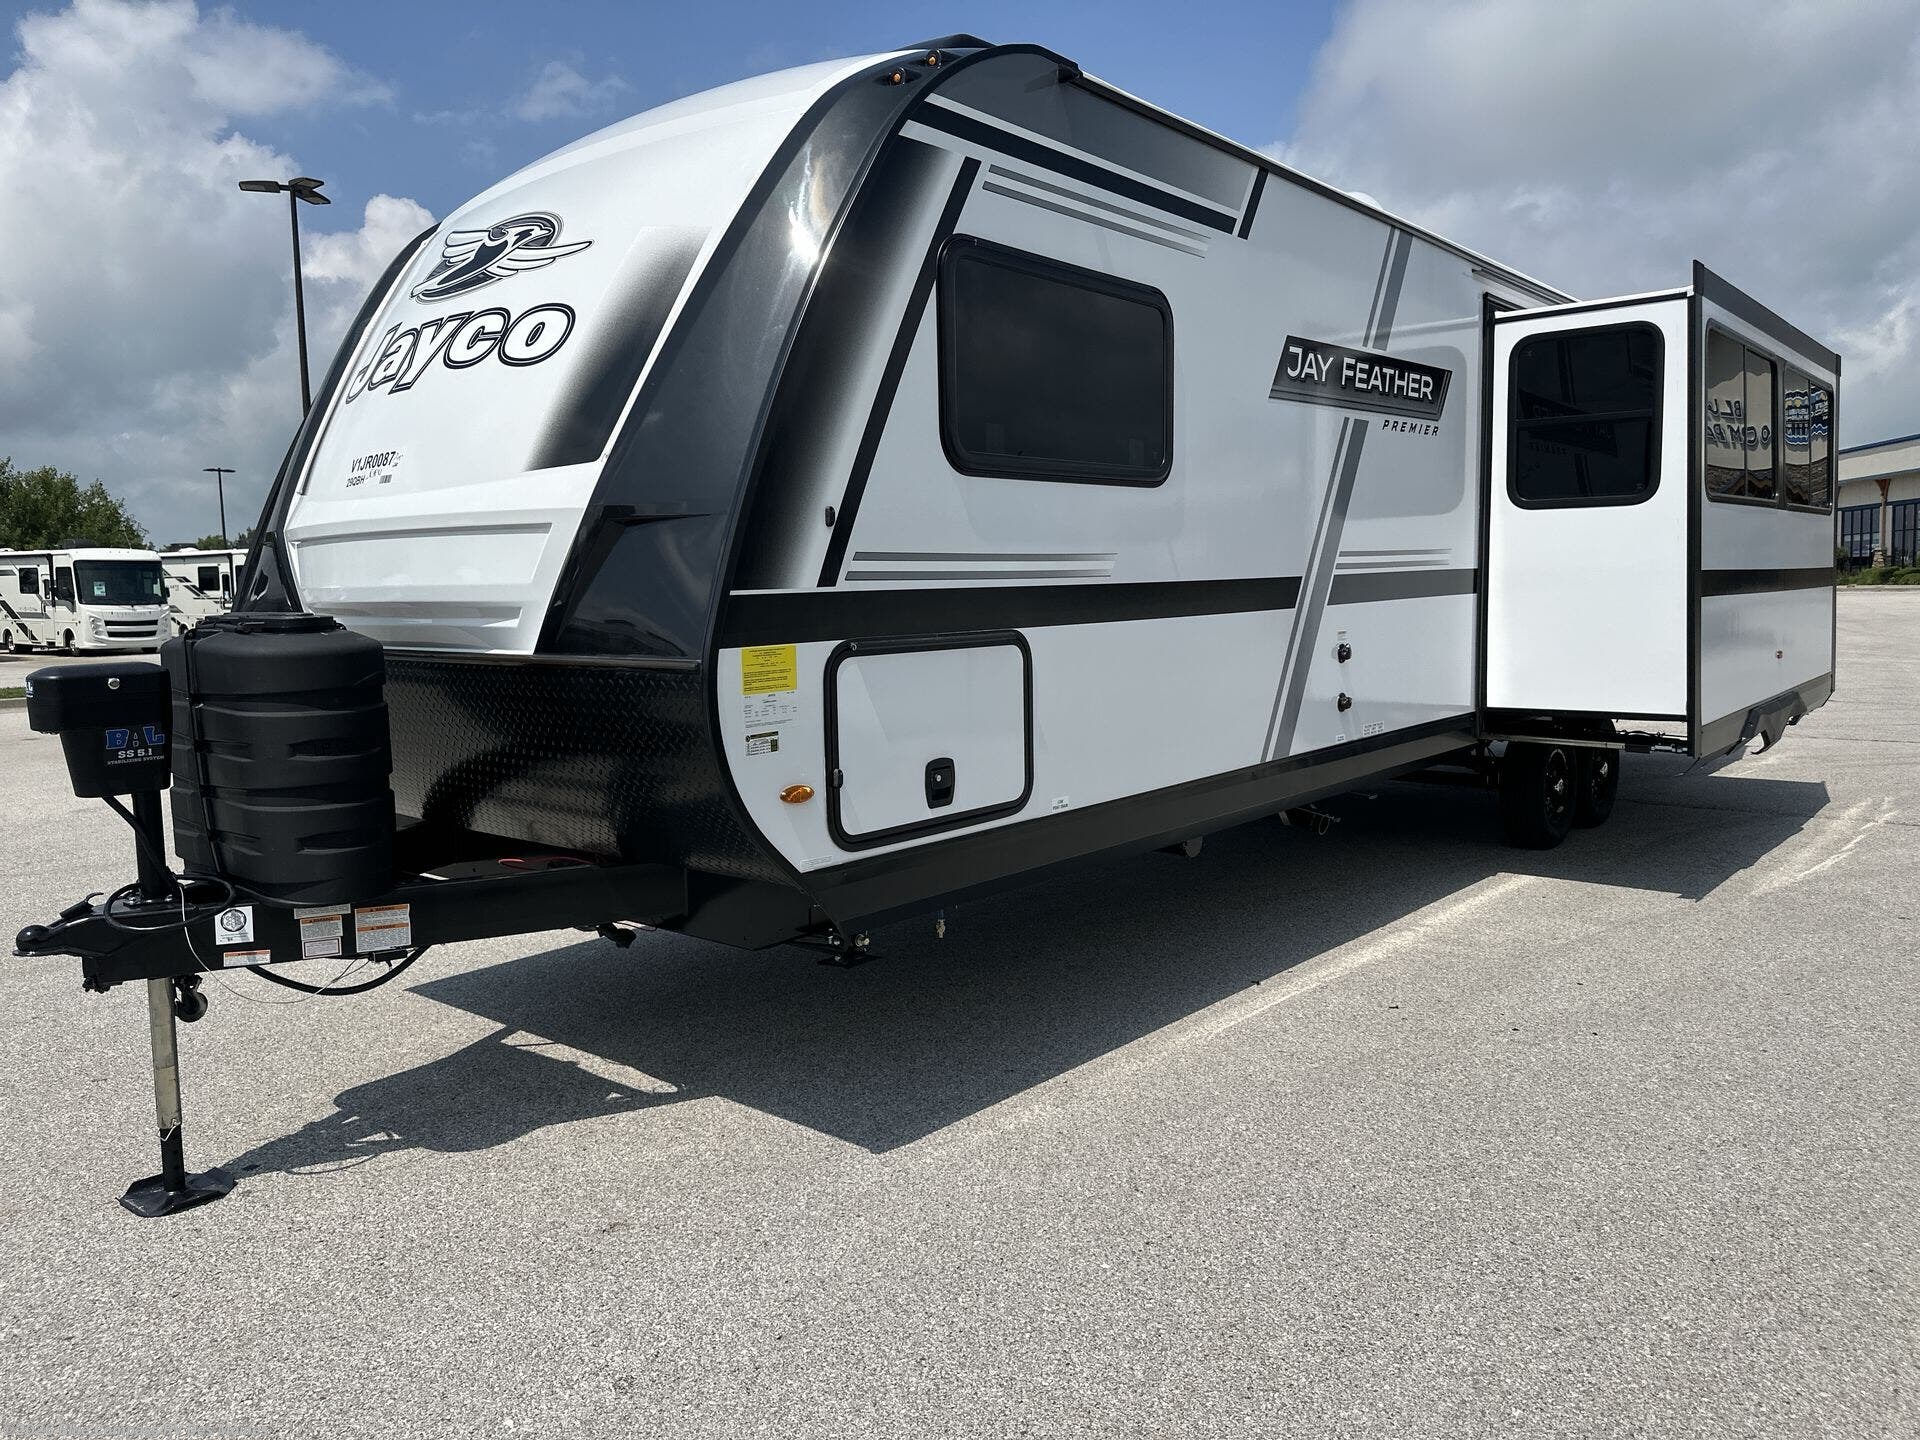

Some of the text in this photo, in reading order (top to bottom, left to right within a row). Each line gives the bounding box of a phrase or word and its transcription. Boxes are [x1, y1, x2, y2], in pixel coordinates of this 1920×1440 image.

[345, 303, 576, 405] Jayco
[1287, 345, 1434, 401] JAY FEATHER
[1382, 419, 1440, 437] PREMIER
[105, 725, 165, 750] BAL
[118, 748, 153, 759] SS 5.1
